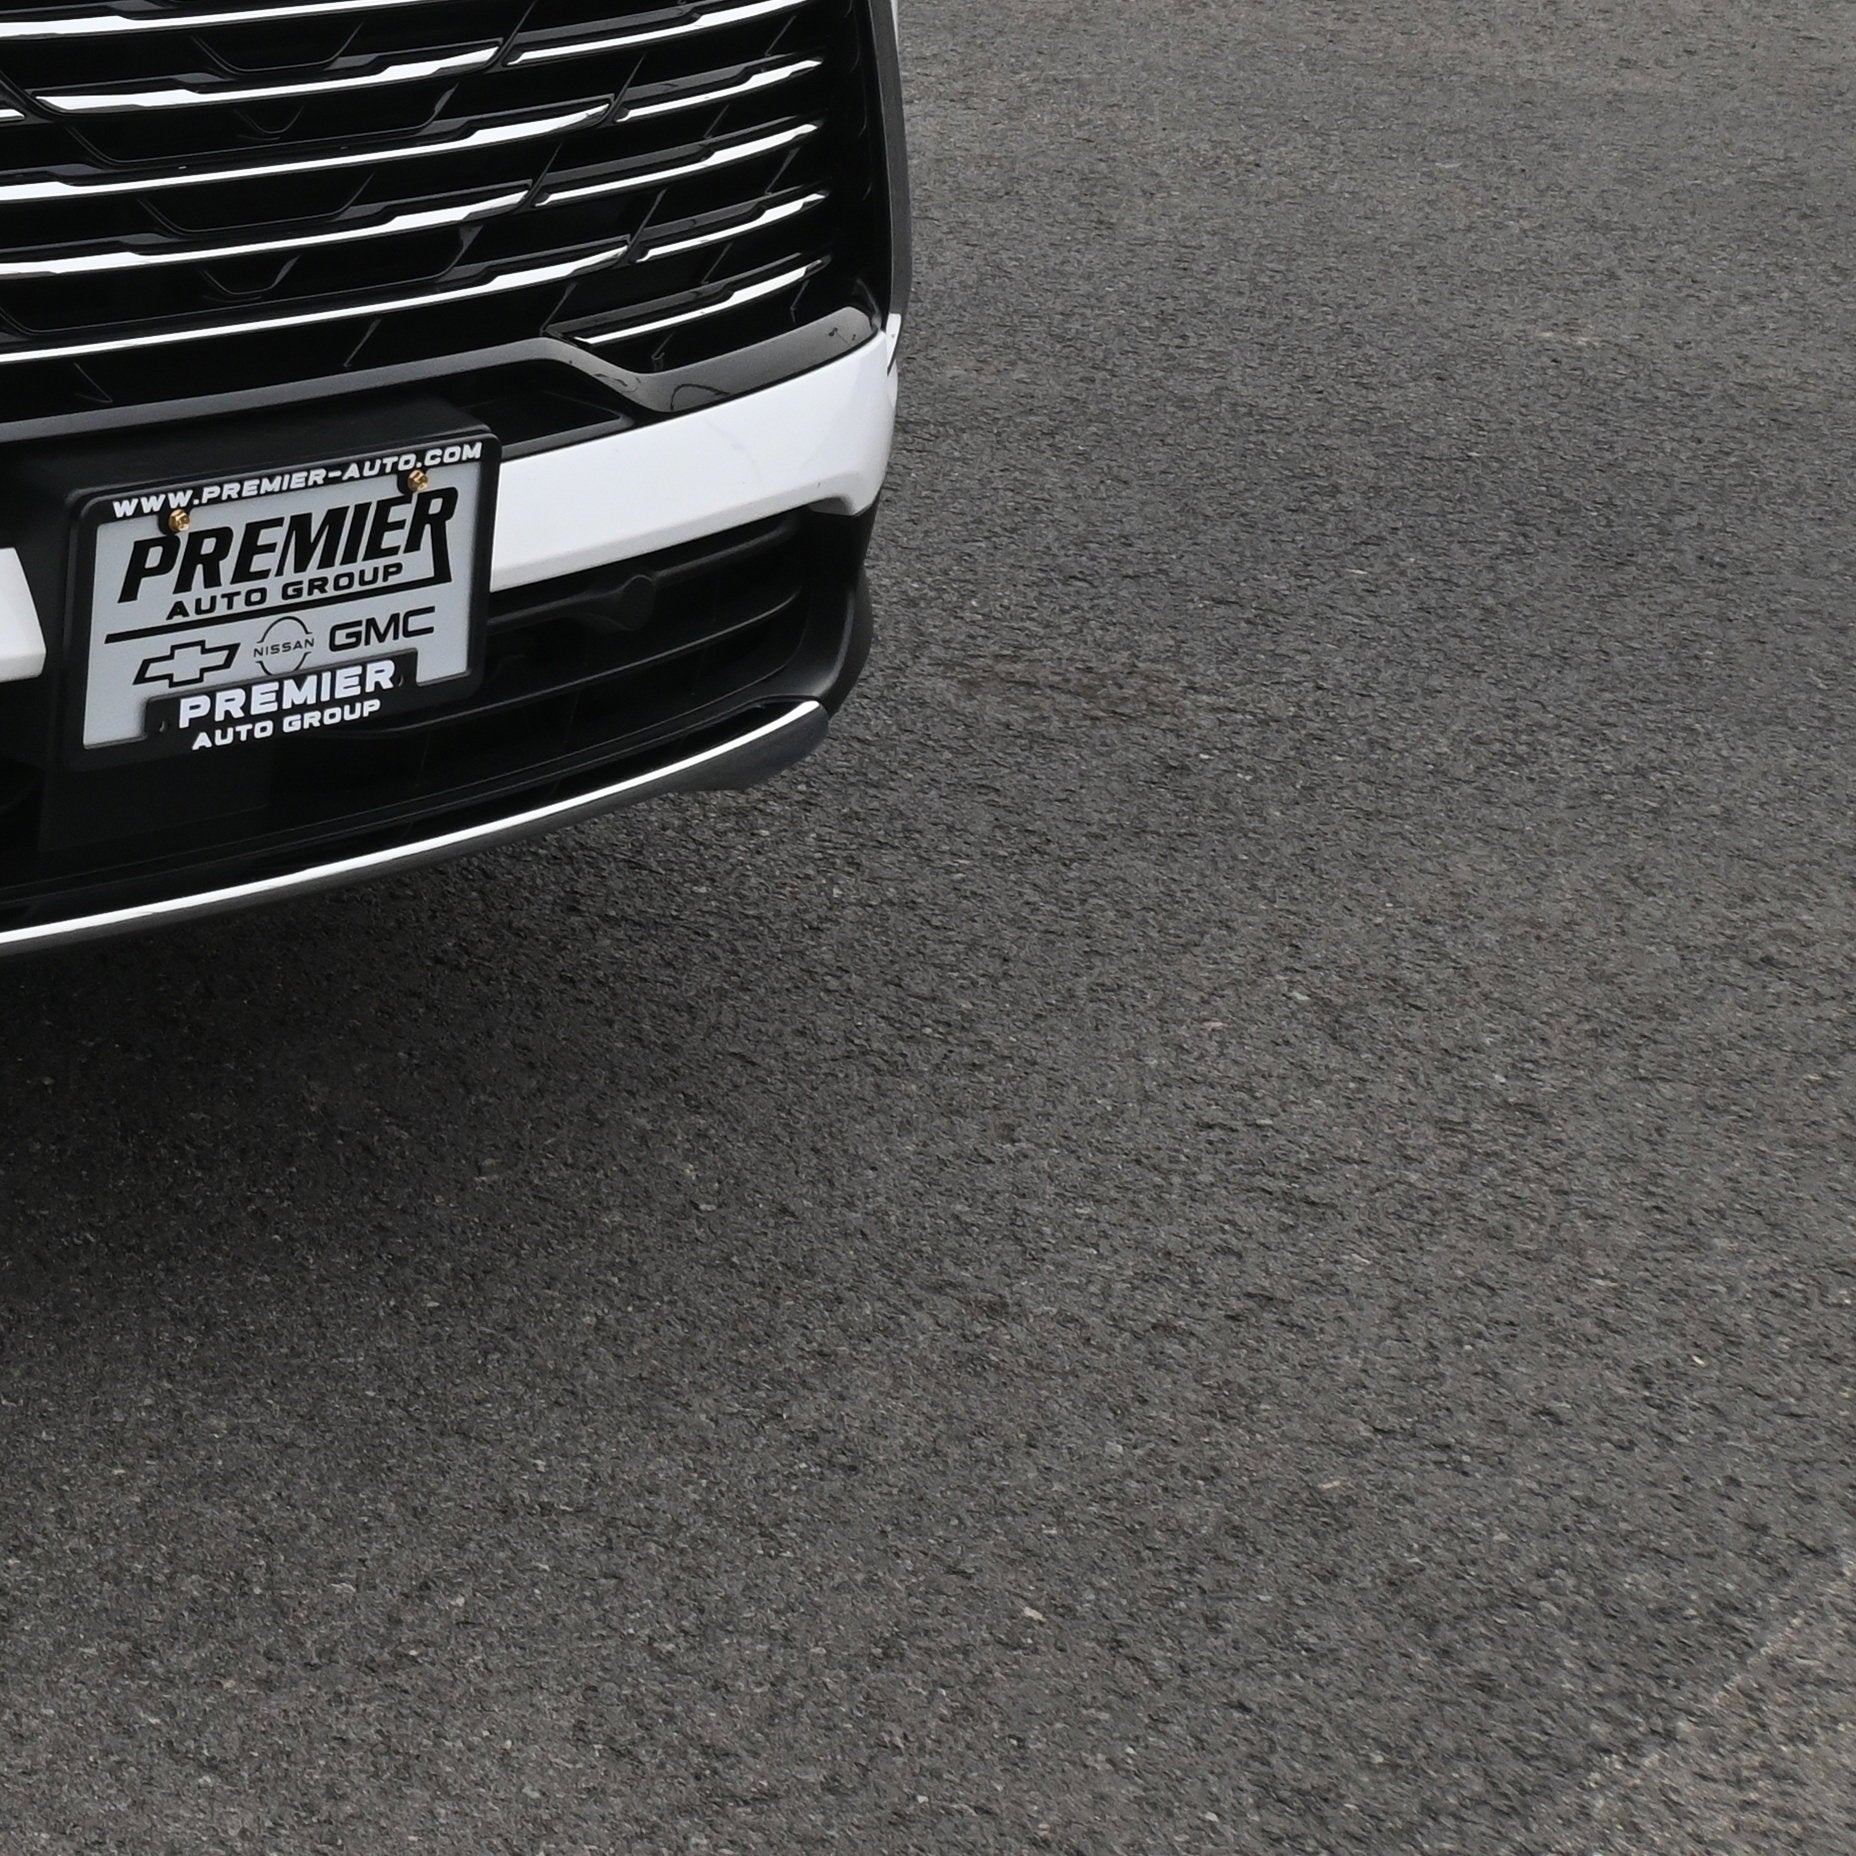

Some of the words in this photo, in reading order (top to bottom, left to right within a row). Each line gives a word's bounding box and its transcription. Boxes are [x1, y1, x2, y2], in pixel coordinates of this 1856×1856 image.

[113, 442, 482, 518] WWW.PREMIER-AUTO.COM
[117, 486, 459, 604] PREMIER
[166, 582, 267, 621] AUTO
[281, 562, 404, 601] GROUP
[253, 637, 315, 658] NISSAN
[329, 606, 436, 652] GMC
[179, 659, 396, 728] PREMIER
[192, 720, 274, 750] AUTO
[283, 699, 381, 732] GROUP
